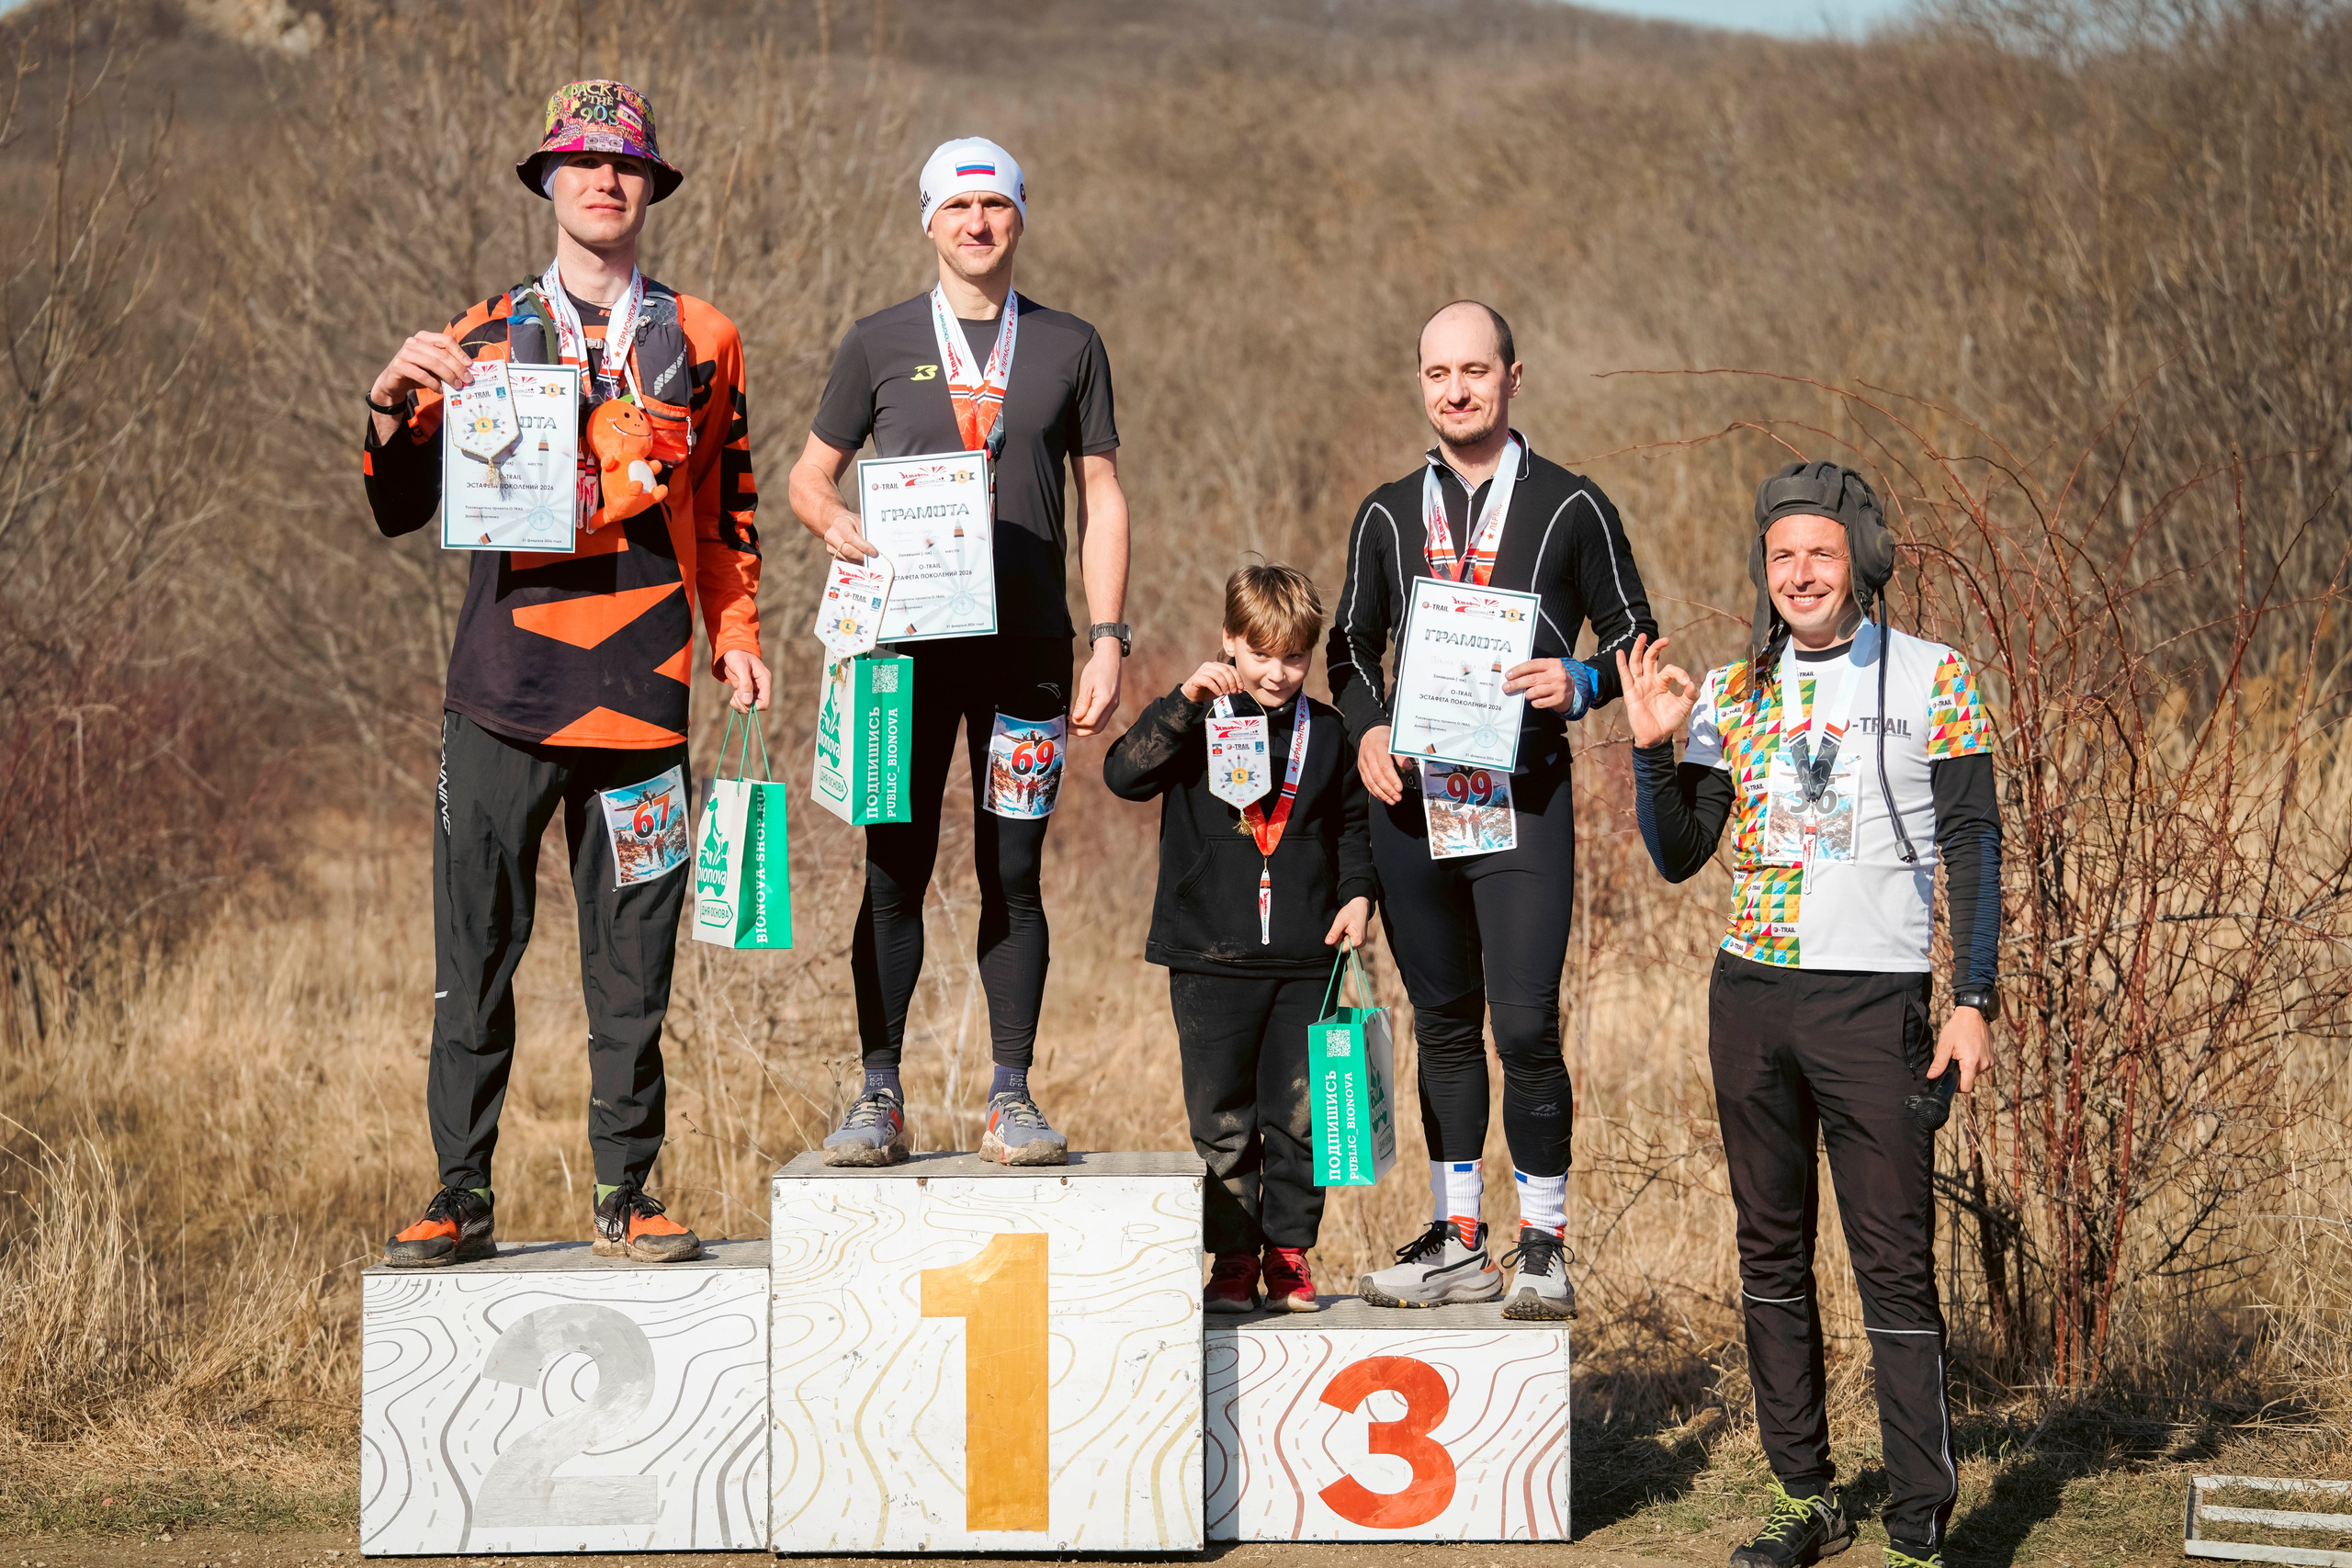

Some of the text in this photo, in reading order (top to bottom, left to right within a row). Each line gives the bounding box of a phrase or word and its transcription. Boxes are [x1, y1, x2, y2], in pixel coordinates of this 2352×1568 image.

[588, 95, 614, 107] THE
[1001, 328, 1012, 370] ЛЕРМОНТОВ
[881, 502, 970, 523] ГРАМОТА
[893, 573, 920, 581] СТАФЕТА
[920, 570, 958, 580] ПОКОЛЕНИЙ
[919, 562, 942, 570] O-TRAIL
[1425, 628, 1512, 653] ГРАМОТА
[1419, 694, 1449, 704] ЭСТАФЕТА
[1450, 698, 1487, 708] ПОКОЛЕНИЙ
[1450, 689, 1473, 698] O-TRAIL
[866, 706, 880, 819] ПОДПИШИСЬ
[887, 707, 899, 818] PUBLIC_BIONOVA
[1011, 739, 1055, 776] 69
[1293, 720, 1306, 765] ЛЕРМОНТОВ
[1446, 770, 1493, 812] 99
[632, 793, 670, 839] 67
[697, 863, 727, 886] bionova
[755, 791, 768, 943] BIONOVA-SHOP.RU
[710, 907, 729, 919] ОСНОВА
[1325, 1069, 1340, 1180] ПОДПИШИСЬ
[1344, 1071, 1359, 1180] PUBLIC_BIONOVA
[921, 1234, 1049, 1532] 1
[471, 1303, 659, 1529] 2
[1317, 1355, 1457, 1529] 3
